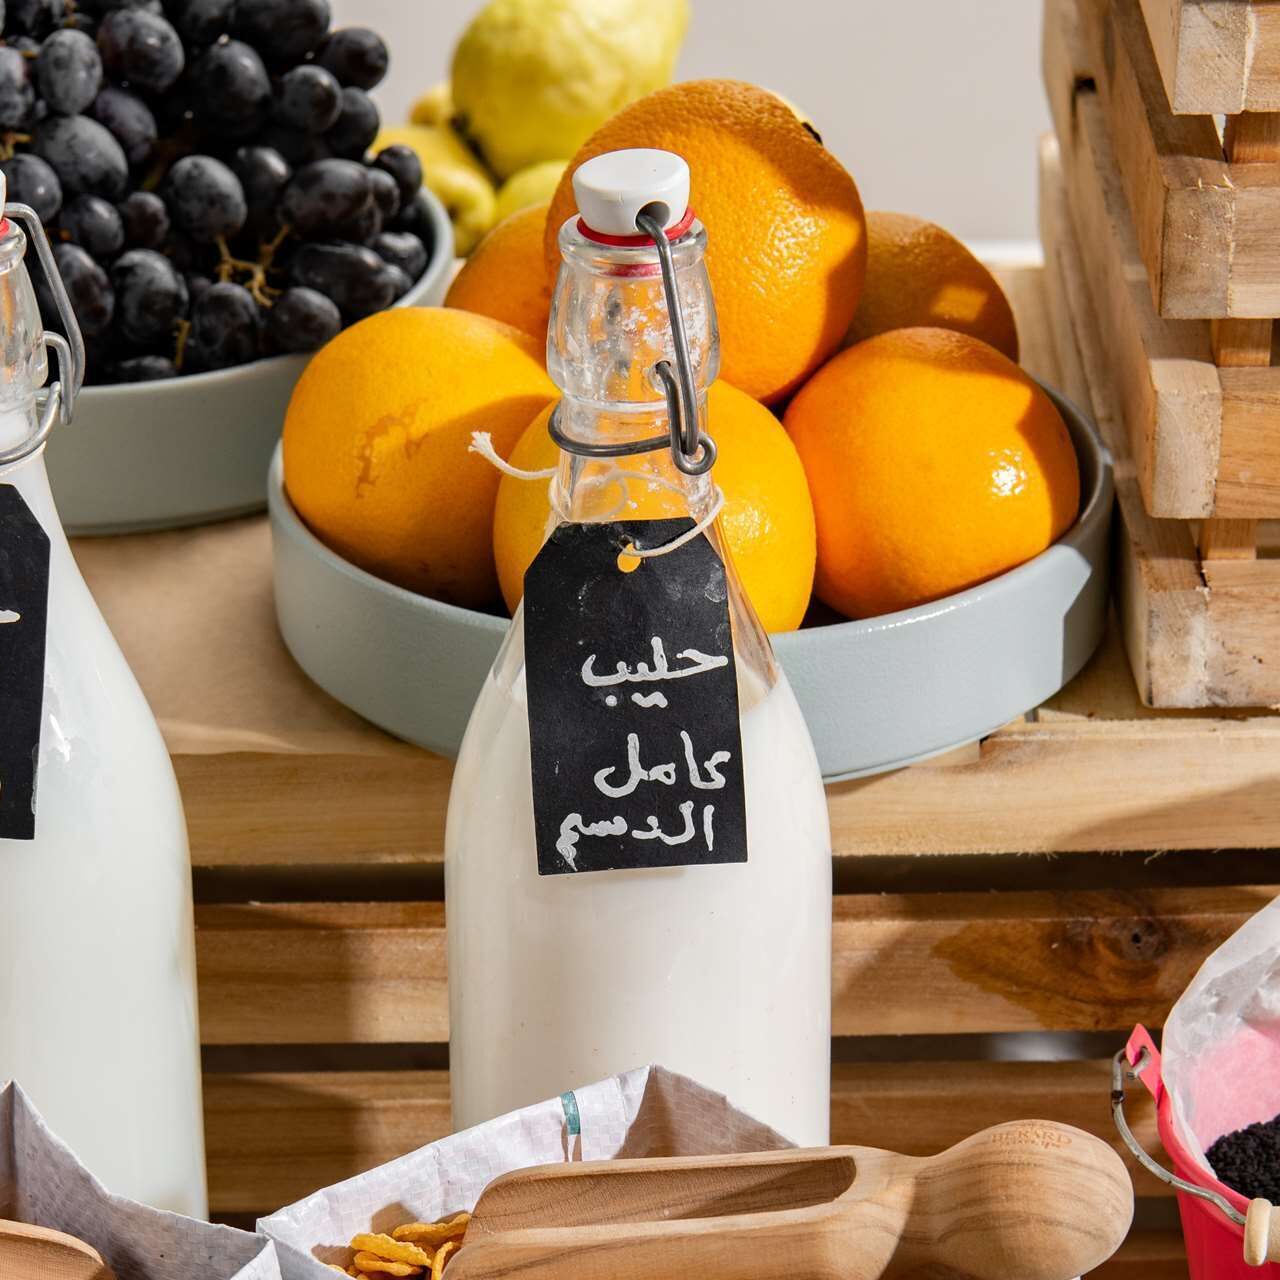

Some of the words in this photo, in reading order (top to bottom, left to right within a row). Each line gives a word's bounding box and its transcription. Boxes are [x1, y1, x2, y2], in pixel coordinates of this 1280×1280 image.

[580, 636, 729, 709] حليب
[593, 730, 732, 799] كامل
[555, 800, 715, 872] الدسم
